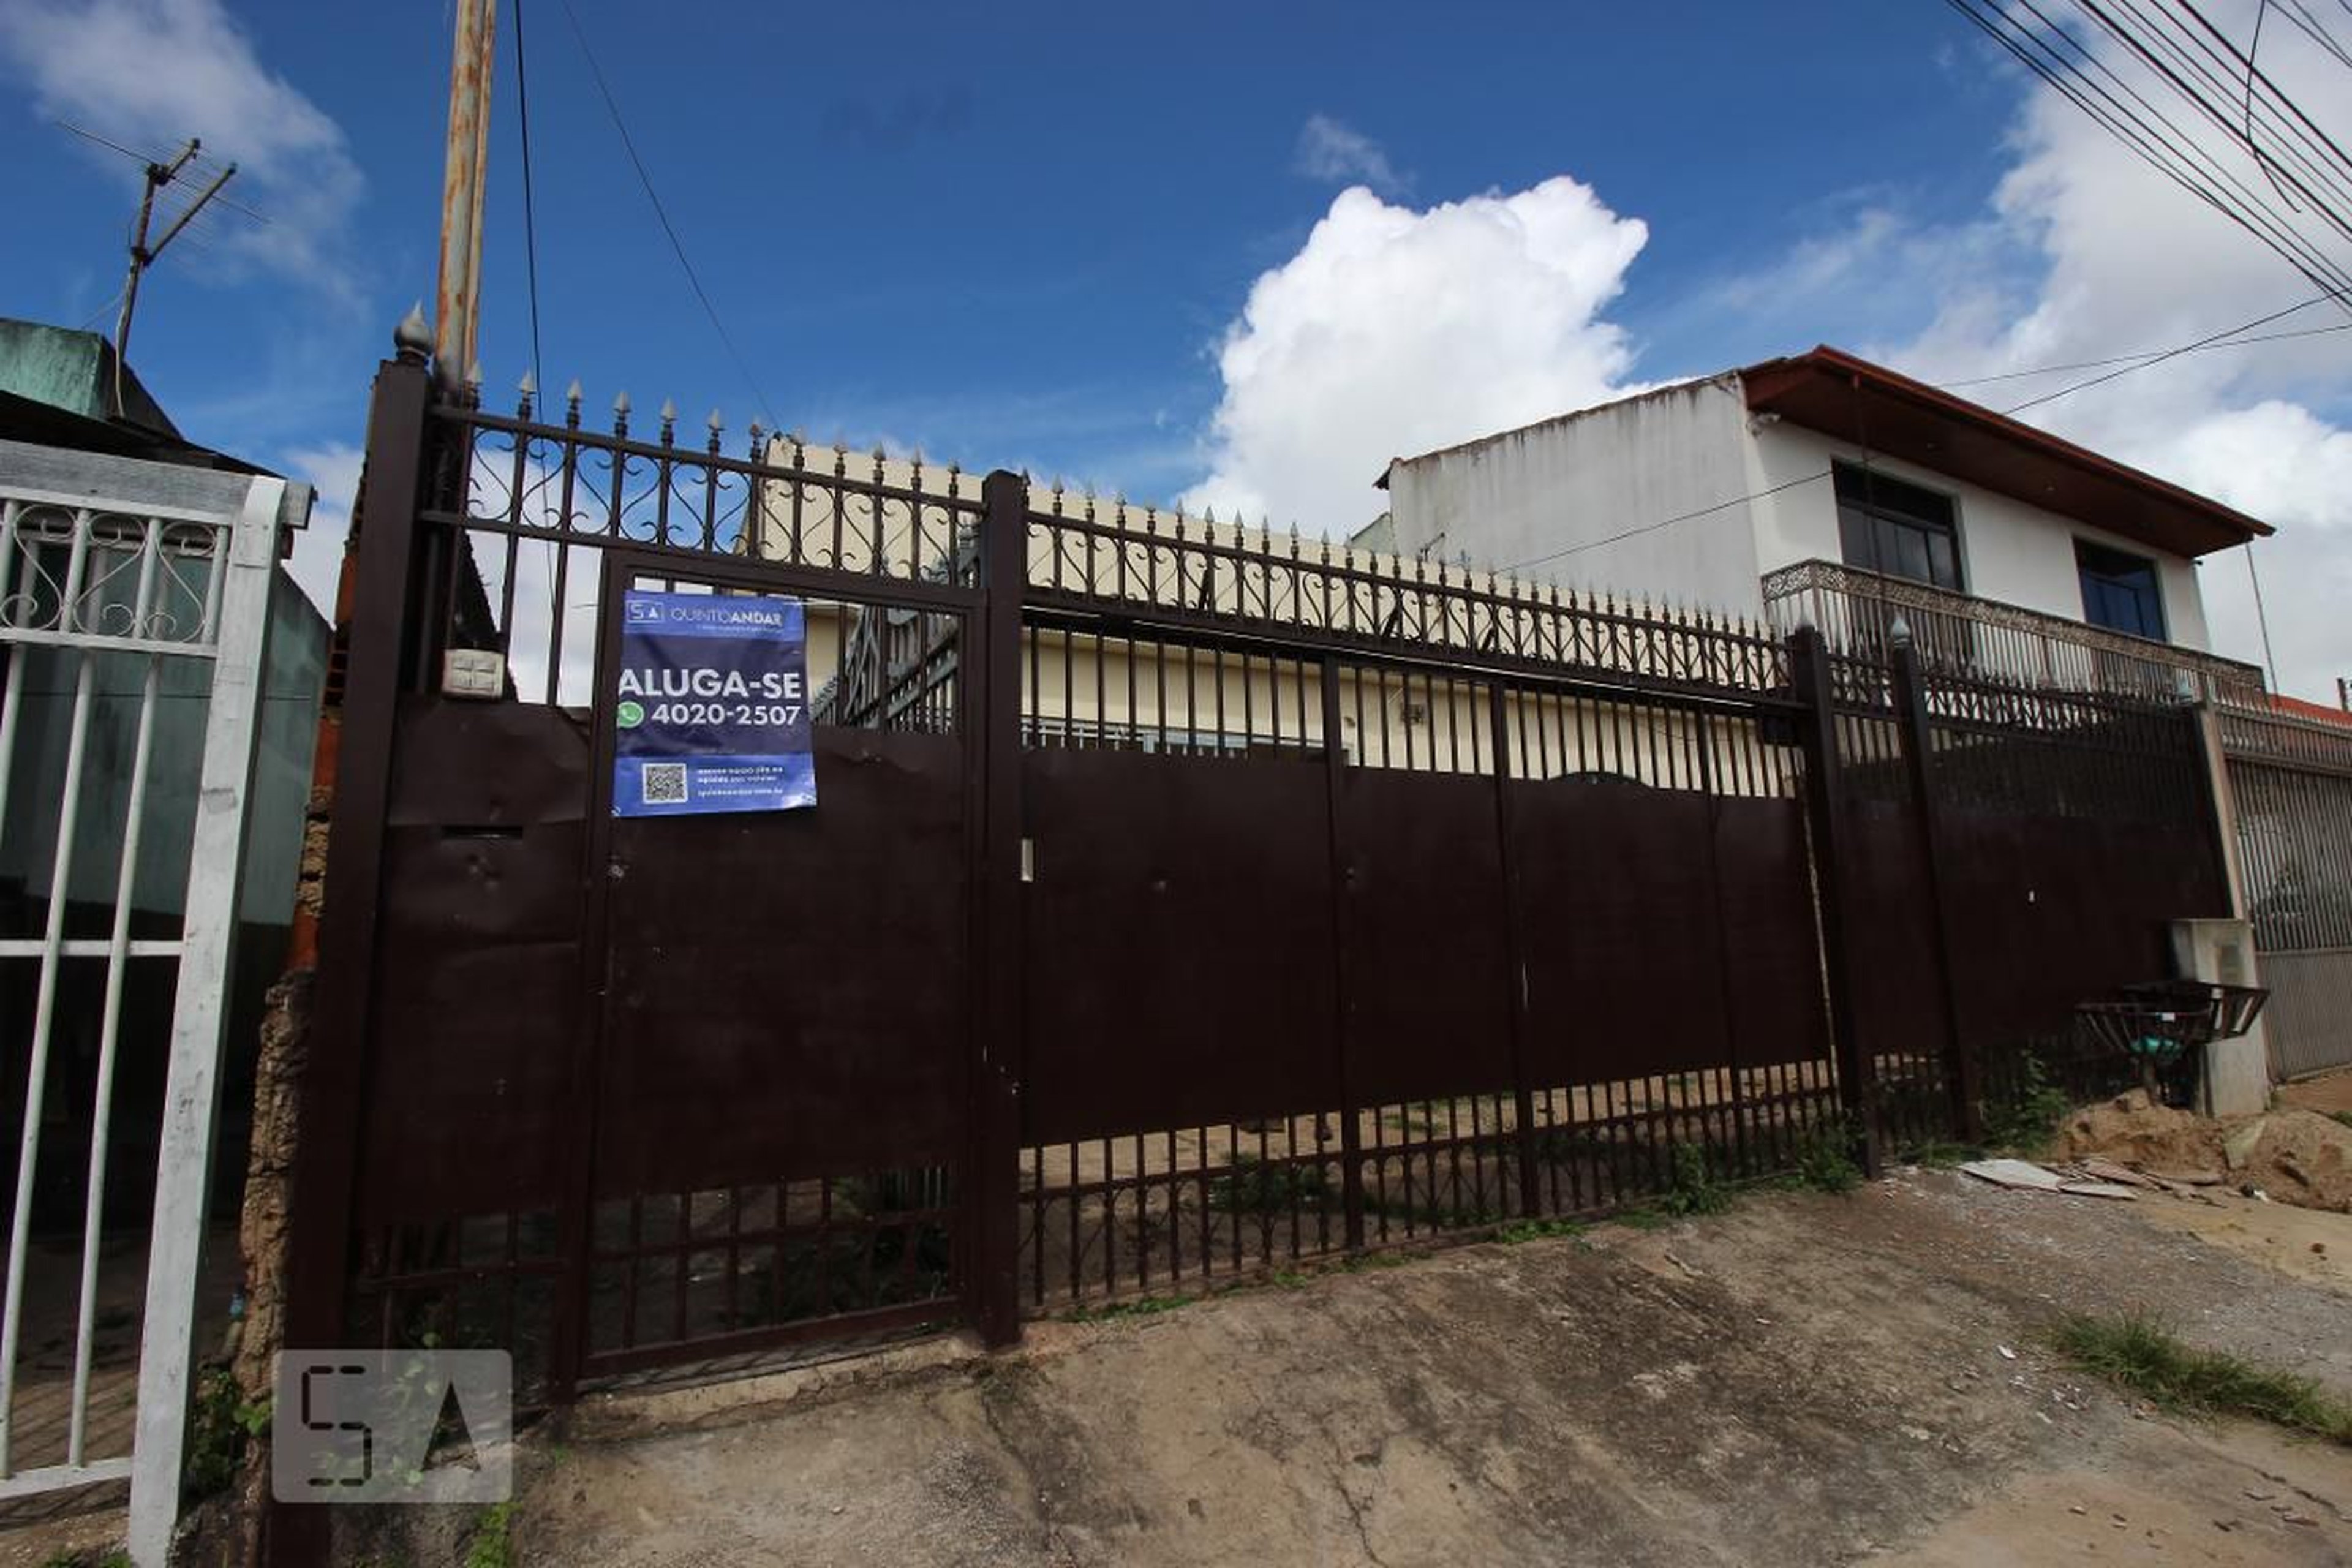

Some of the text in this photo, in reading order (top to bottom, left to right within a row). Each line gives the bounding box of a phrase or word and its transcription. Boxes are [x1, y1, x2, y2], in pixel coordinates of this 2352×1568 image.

[671, 606, 783, 626] QUINTOANDAR
[618, 668, 801, 699] ALUGA-SE
[651, 703, 801, 726] 4020-2507
